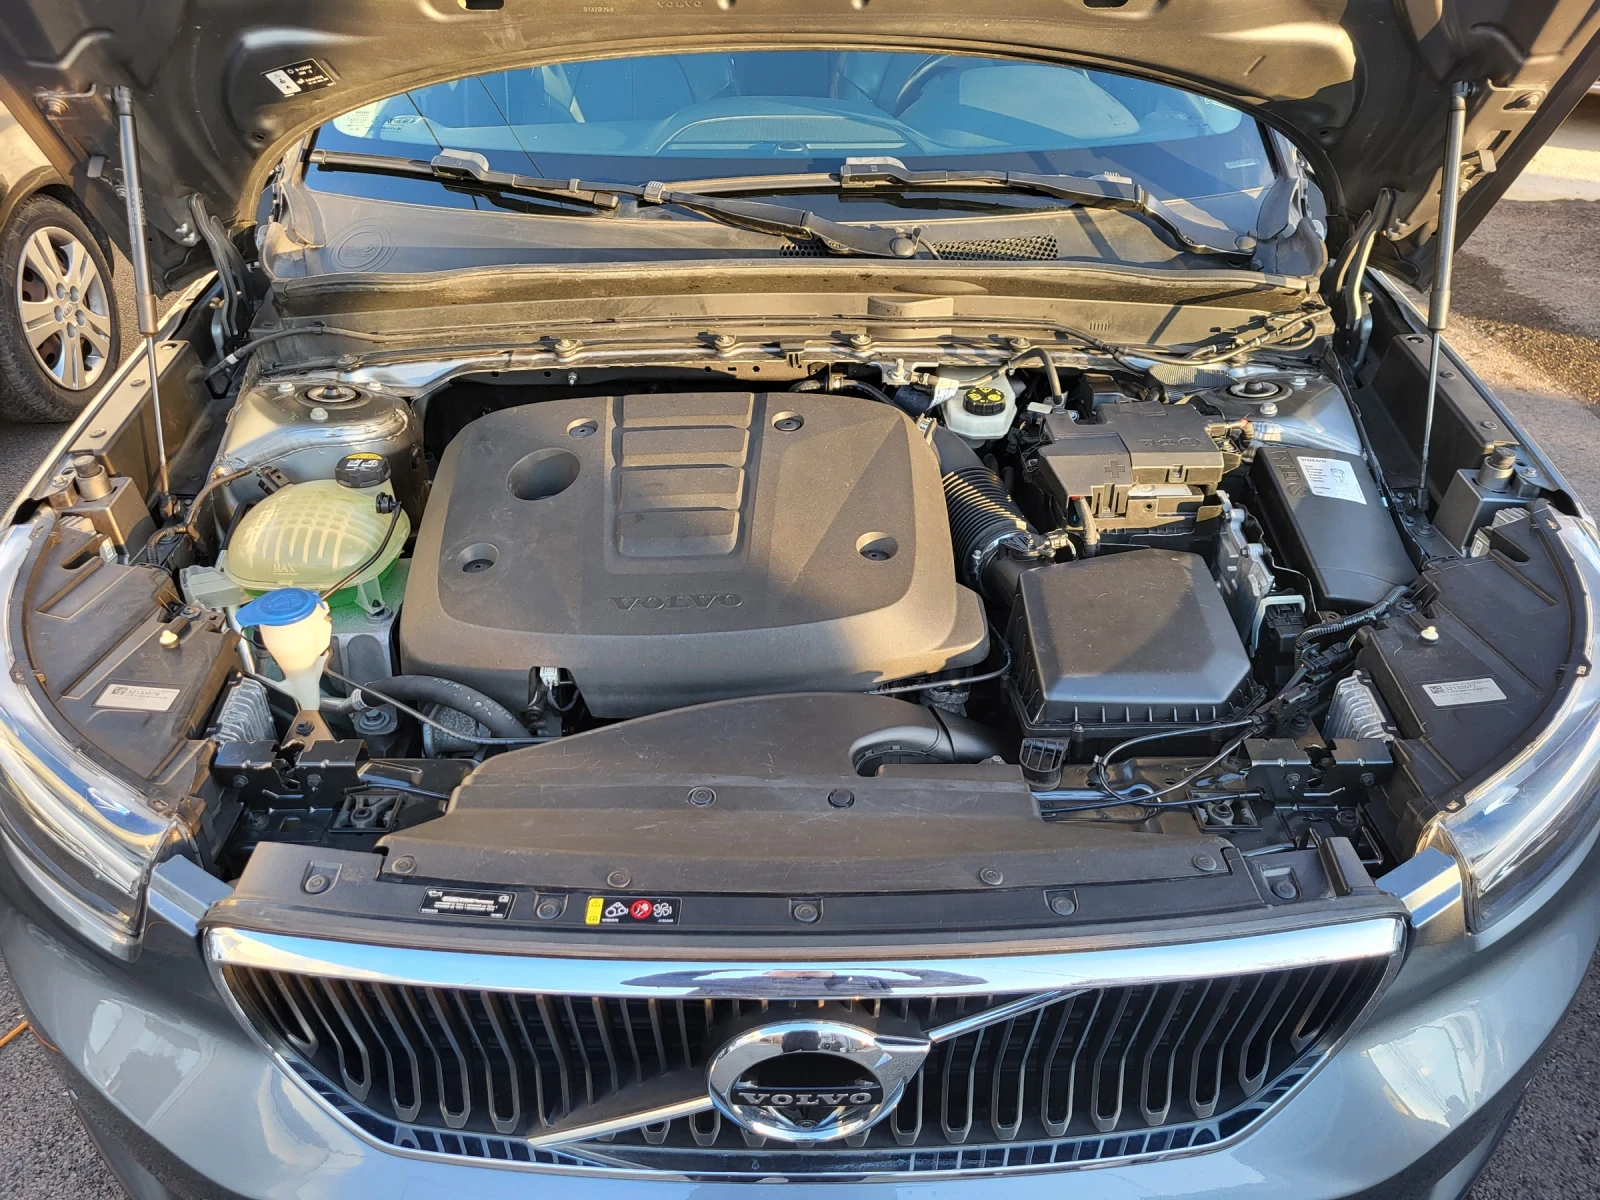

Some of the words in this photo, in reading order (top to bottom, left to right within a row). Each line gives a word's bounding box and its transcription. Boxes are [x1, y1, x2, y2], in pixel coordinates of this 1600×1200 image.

[657, 0, 702, 8] VOLVO
[273, 563, 296, 573] MAX
[608, 593, 744, 611] VOLVO
[738, 1092, 872, 1105] VOLVO
